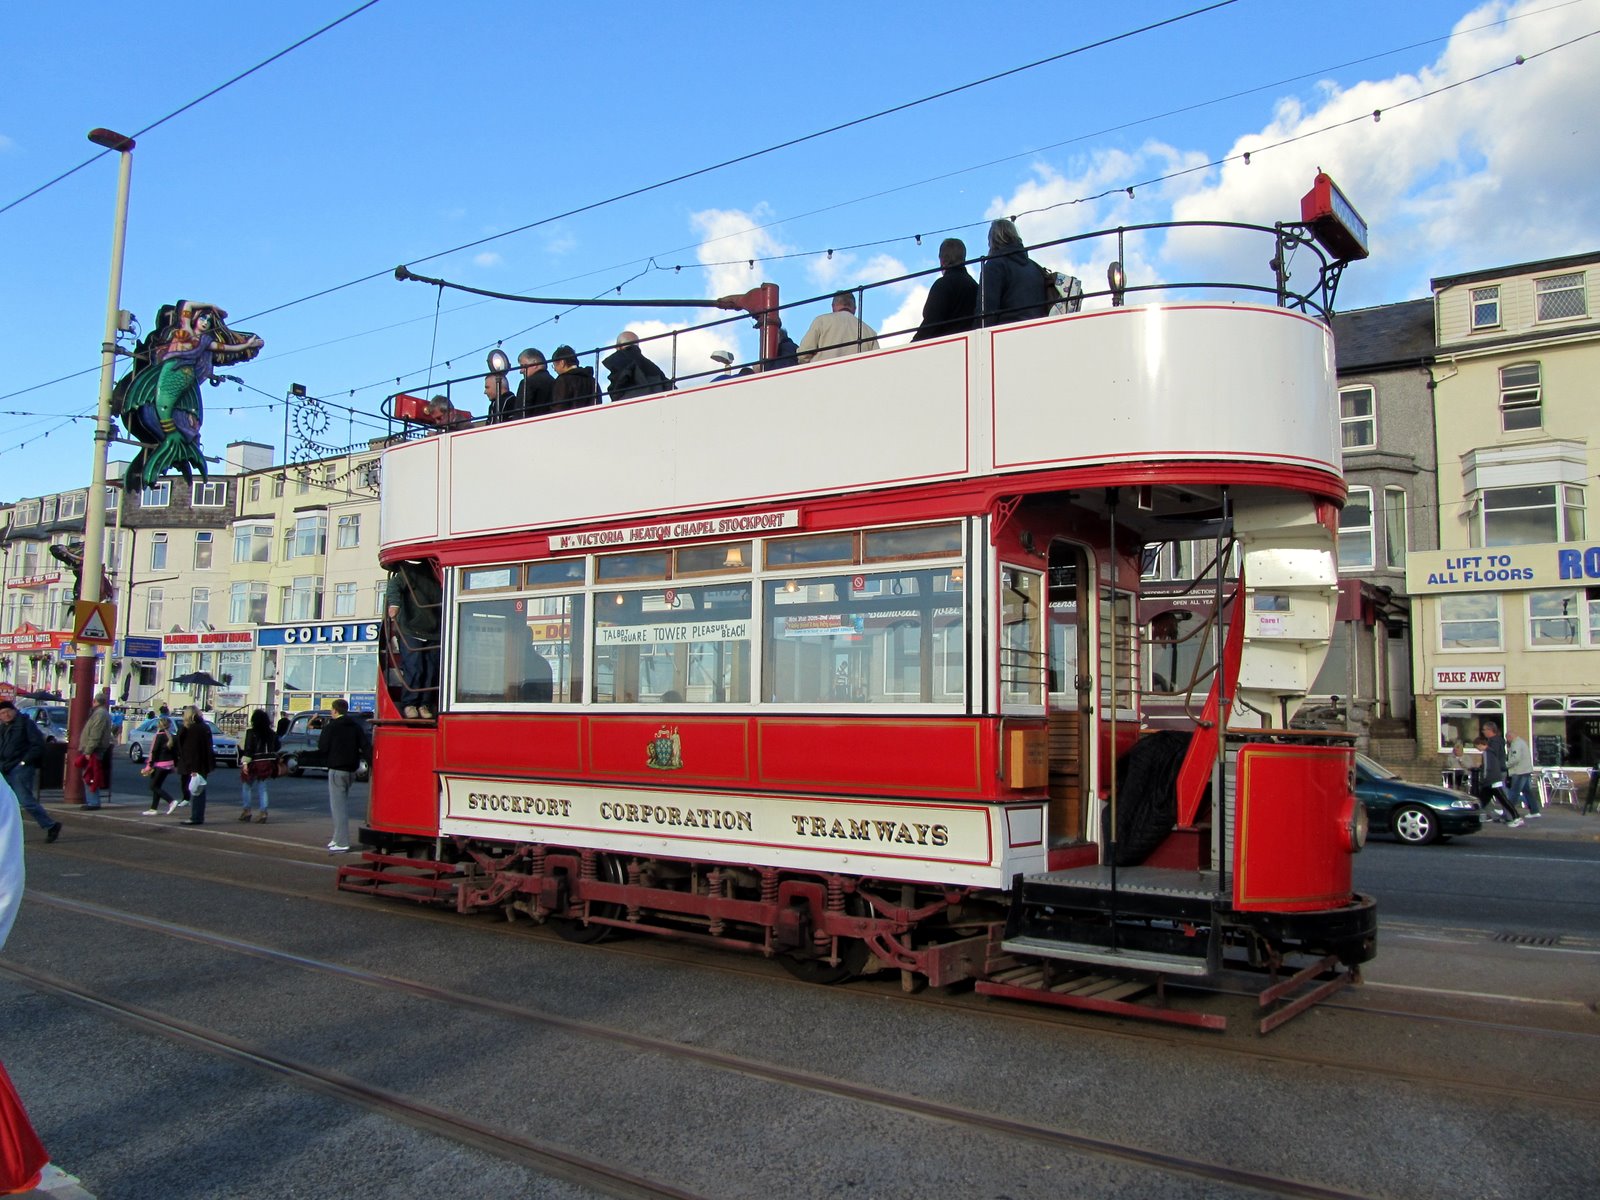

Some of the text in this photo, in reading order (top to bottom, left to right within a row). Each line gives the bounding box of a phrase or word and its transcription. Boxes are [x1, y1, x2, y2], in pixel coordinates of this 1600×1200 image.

[577, 530, 624, 546] VICTORIA
[629, 525, 671, 542] HEATON
[674, 520, 716, 537] CHAPEL
[719, 513, 785, 533] STOCKPORT
[1446, 554, 1511, 570] LIFT TO
[1427, 567, 1534, 585] ALL FLOORS
[284, 624, 379, 643] COLRIS
[603, 623, 746, 642] TALBOT SQUARE TOWER PLEASURE BEACH
[1437, 671, 1501, 683] TAKE AWAY
[468, 792, 949, 847] STOCKPORT CORPORATION TRAMWAYS
